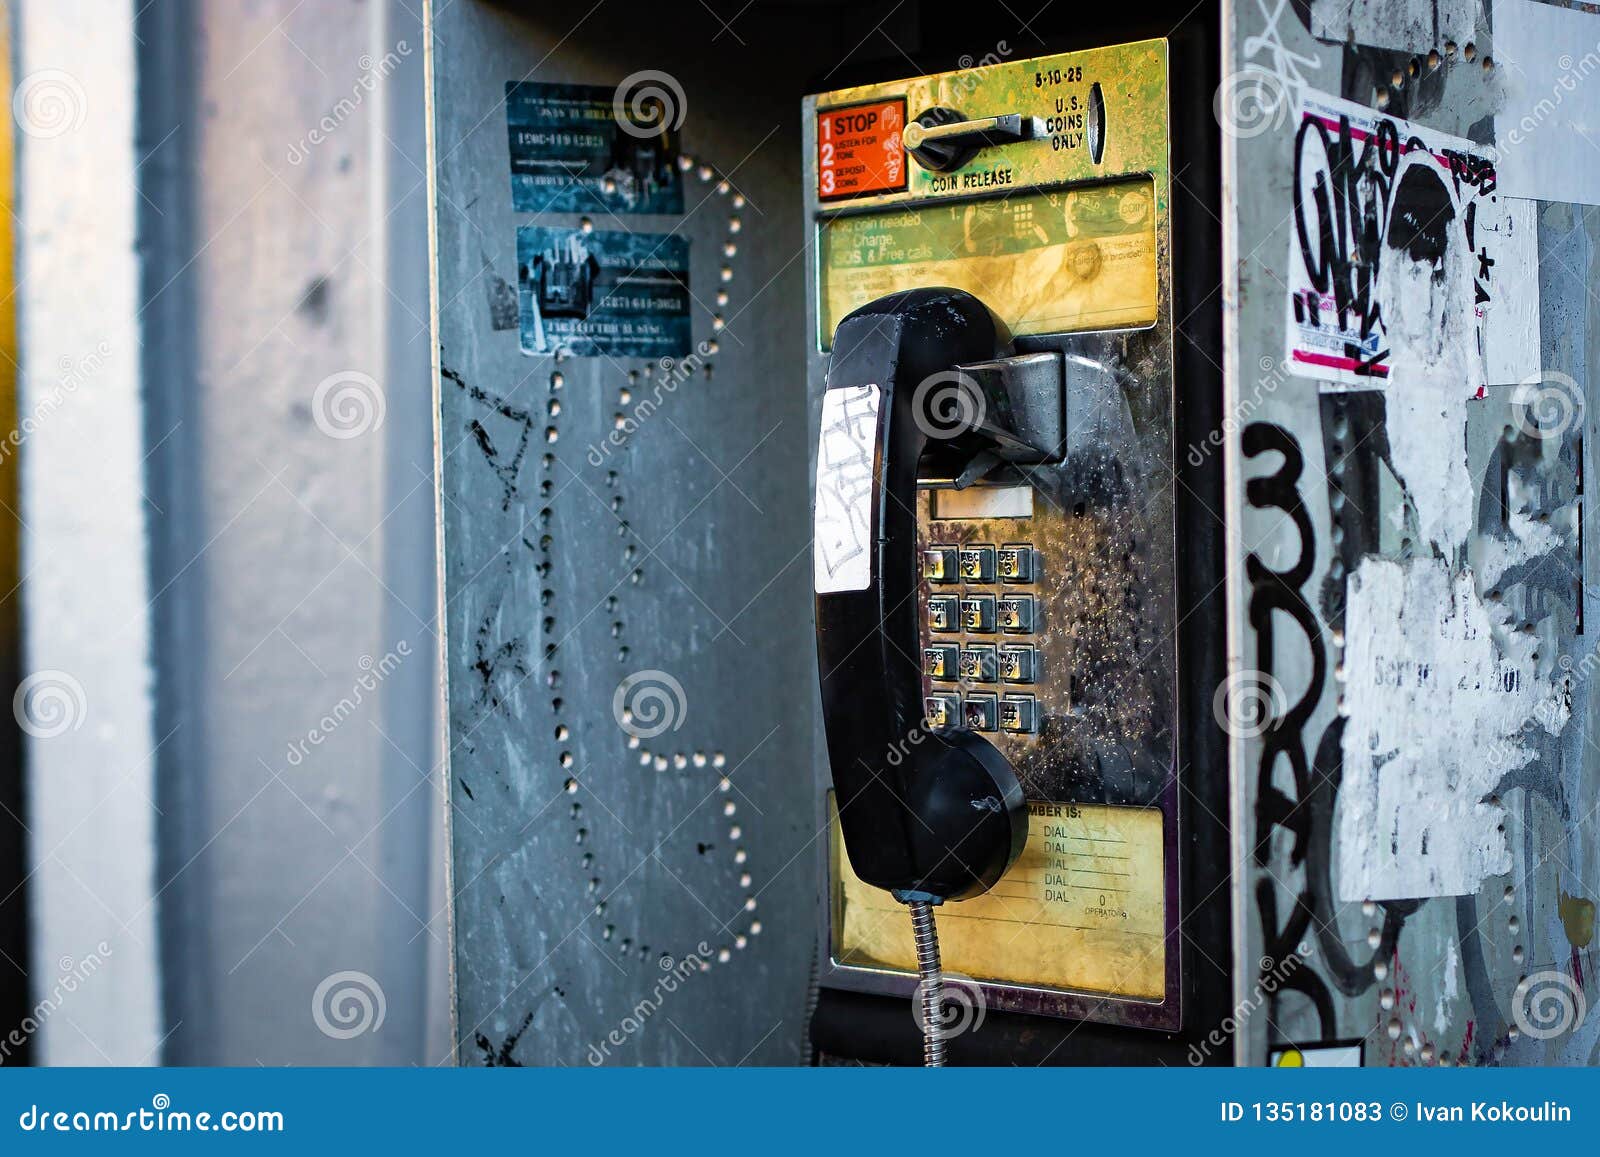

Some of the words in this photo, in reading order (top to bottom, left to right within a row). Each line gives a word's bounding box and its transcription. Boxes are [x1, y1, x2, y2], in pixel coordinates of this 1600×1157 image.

[1055, 96, 1083, 113] U.S.
[822, 118, 831, 140] 1
[834, 112, 877, 135] STOP
[1046, 114, 1083, 133] COINS
[1052, 133, 1083, 151] ONLY
[822, 143, 834, 166] 2
[861, 136, 877, 145] FOR
[821, 170, 835, 193] 3
[932, 175, 958, 192] COIN
[963, 169, 1012, 188] RELEASE
[879, 213, 921, 229] needed
[878, 246, 905, 262] Free
[935, 613, 942, 626] 4
[967, 613, 975, 626] 5
[1005, 613, 1012, 626] 6
[931, 662, 938, 674] 7
[1005, 664, 1013, 677] 9
[1065, 806, 1081, 819] IS:
[1043, 825, 1068, 838] DIAL
[1043, 841, 1068, 855] DIAL
[1044, 873, 1069, 887] DIAL
[1045, 889, 1070, 903] DIAL
